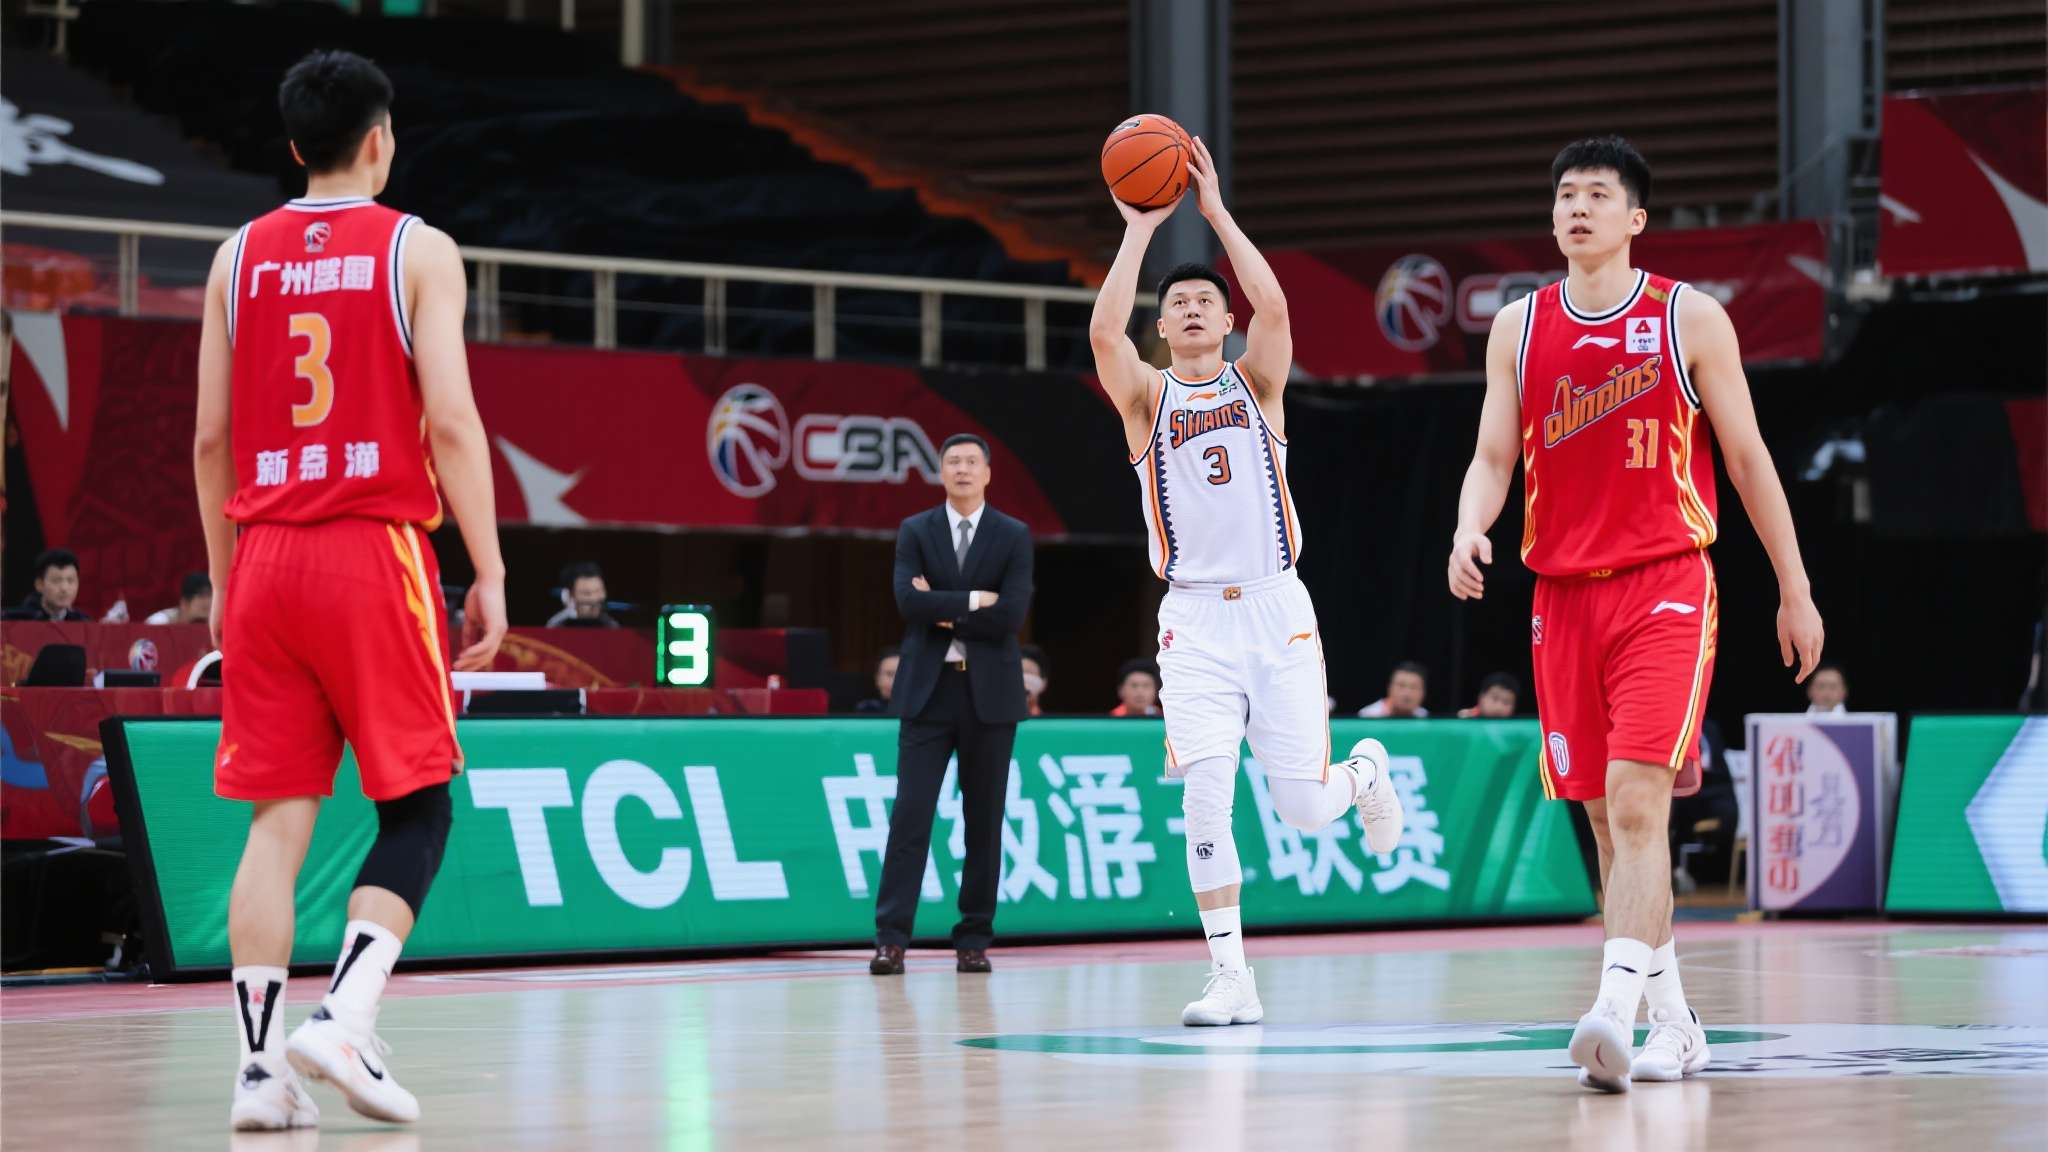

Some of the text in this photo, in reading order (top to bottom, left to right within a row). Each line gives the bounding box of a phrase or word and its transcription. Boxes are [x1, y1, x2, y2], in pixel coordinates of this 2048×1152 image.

[288, 312, 335, 428] 3
[792, 414, 941, 485] CBA
[1203, 445, 1232, 485] 3
[1625, 418, 1659, 469] 31
[667, 612, 709, 685] 3
[467, 759, 789, 909] TCL
